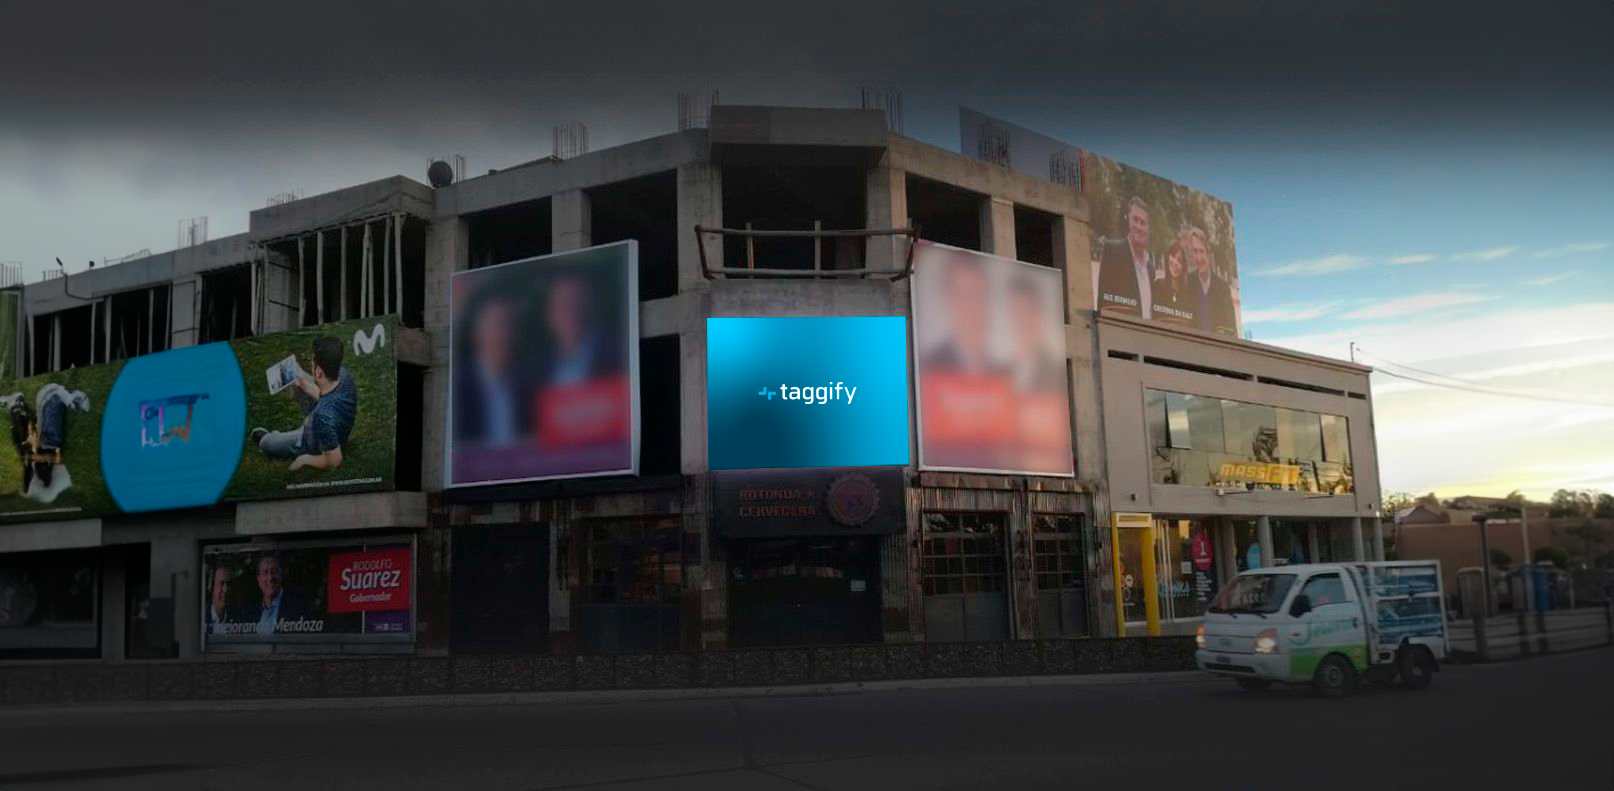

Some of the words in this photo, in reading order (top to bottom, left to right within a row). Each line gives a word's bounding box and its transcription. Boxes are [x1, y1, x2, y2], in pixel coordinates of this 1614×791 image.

[780, 381, 857, 404] taggify
[340, 567, 401, 591] Suarez
[272, 616, 324, 632] Mendoza
